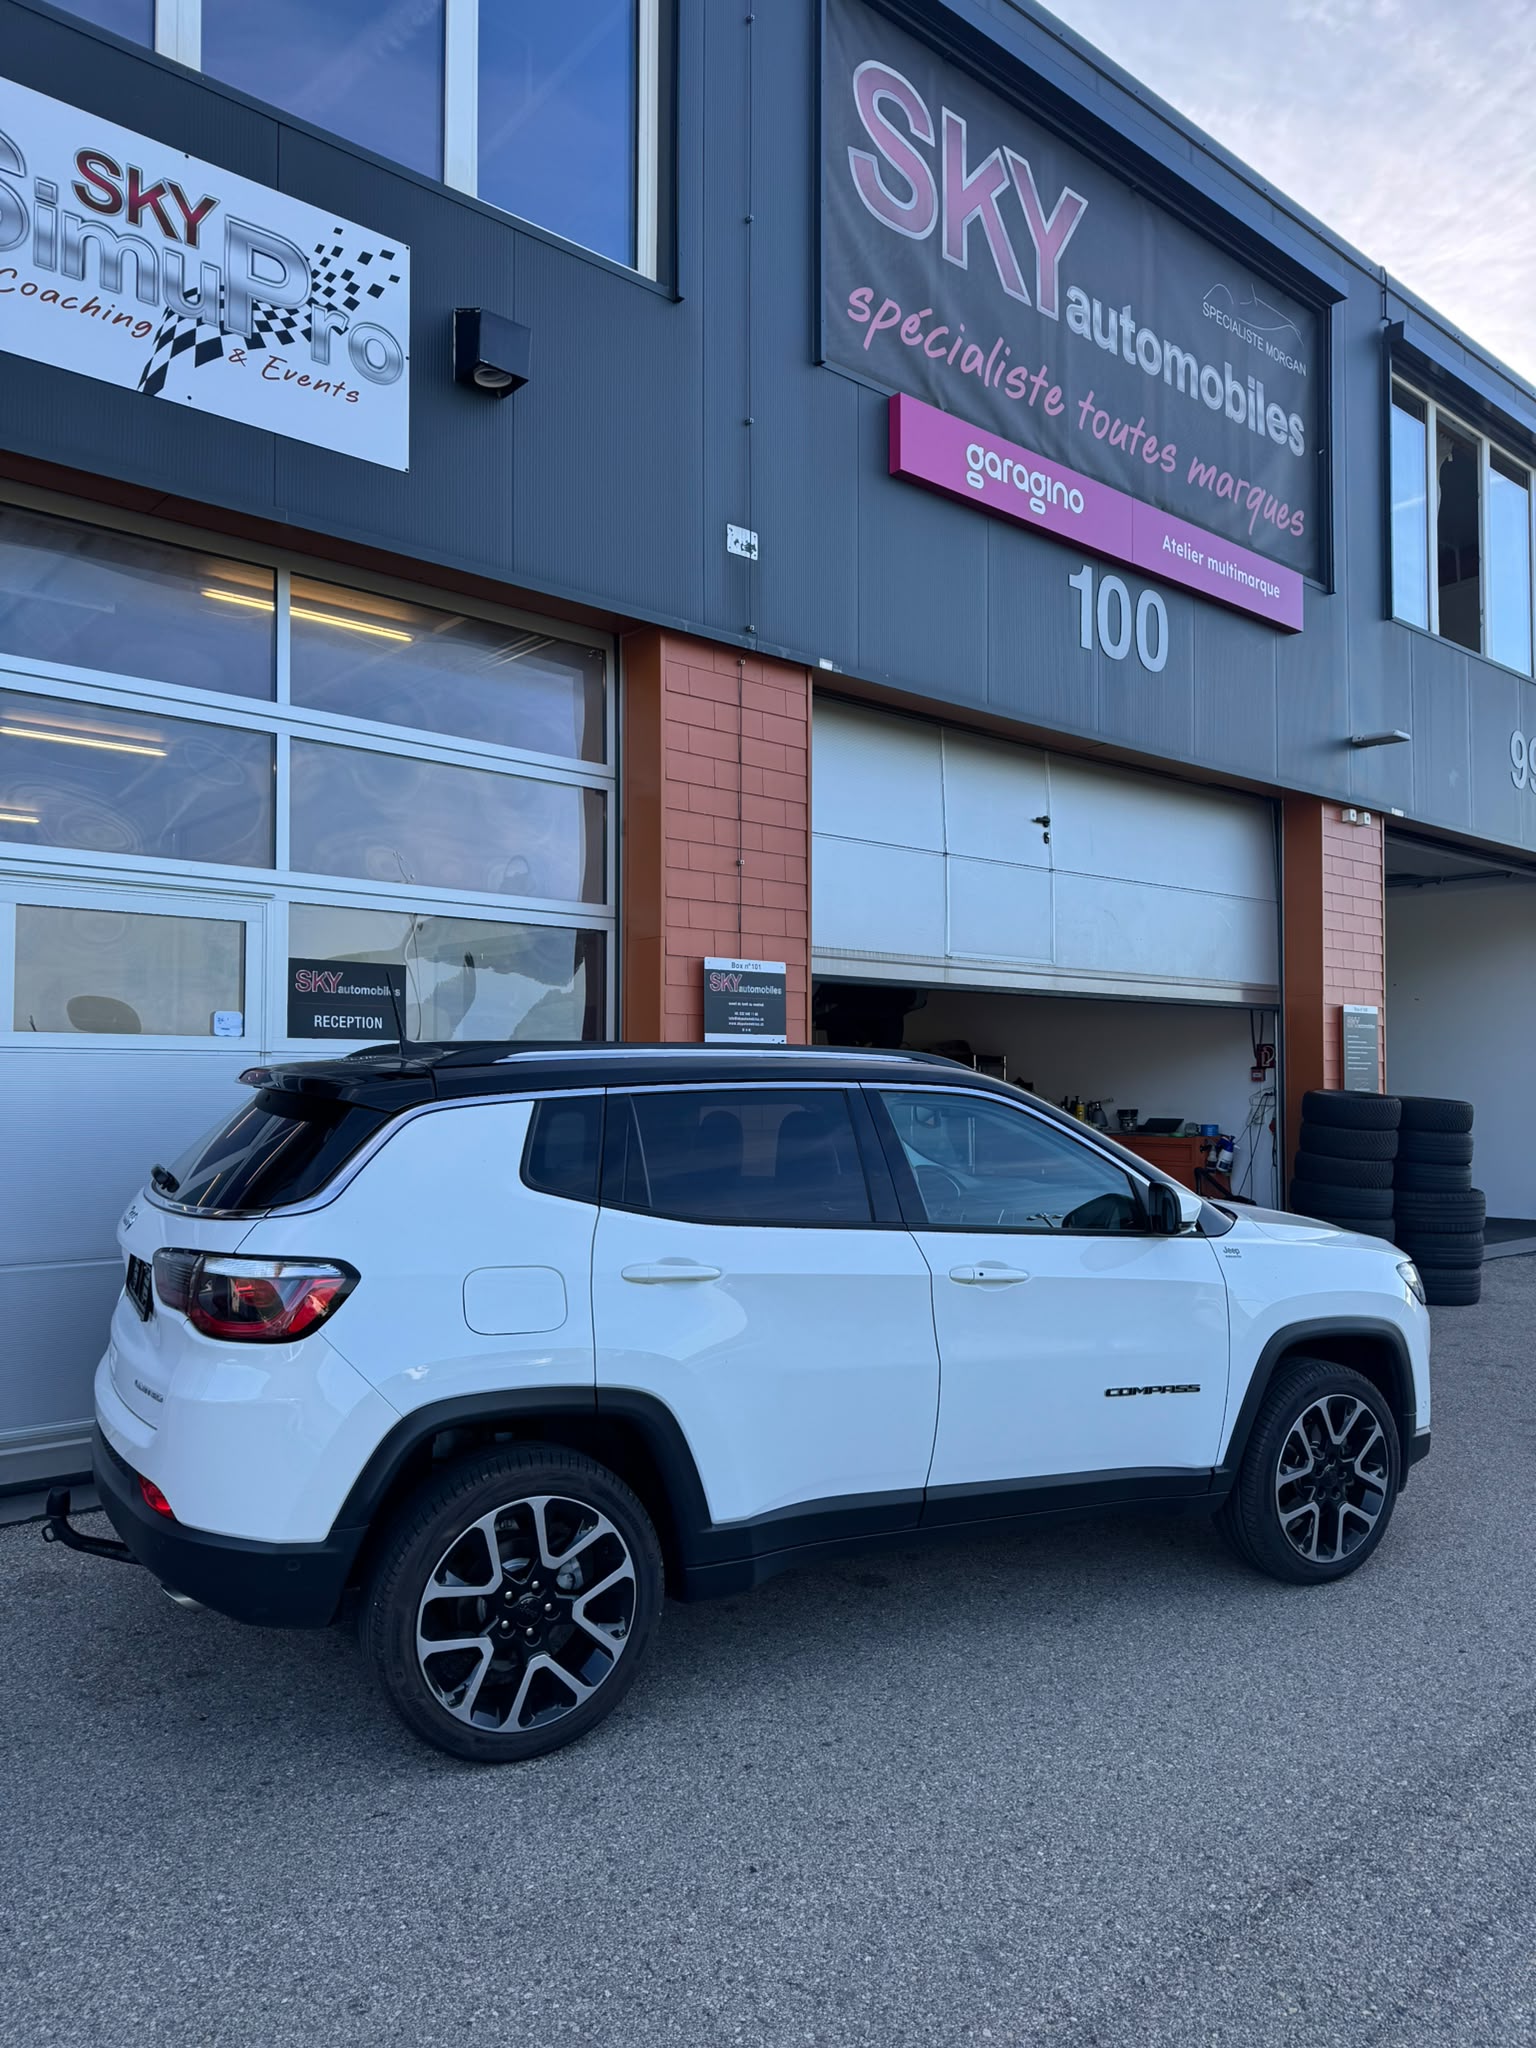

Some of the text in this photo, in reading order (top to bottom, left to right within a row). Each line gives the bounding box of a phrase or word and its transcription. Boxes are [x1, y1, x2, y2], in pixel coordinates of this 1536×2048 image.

[71, 147, 221, 249] SKY
[847, 60, 1306, 456] SKY automobiles
[0, 267, 360, 404] Coaching & Events
[1202, 301, 1307, 377] SPECIALISTE MORGAN
[847, 286, 1305, 537] spécialiste toutes marques
[966, 443, 1084, 515] garagino
[1162, 535, 1280, 599] Atelier multimarque
[1068, 564, 1169, 673] 100
[295, 969, 344, 993] SKY
[709, 971, 782, 995] SKY automobiles
[731, 961, 743, 969] Box
[314, 1014, 383, 1029] RECEPTION
[1104, 1384, 1201, 1398] COMPASS
